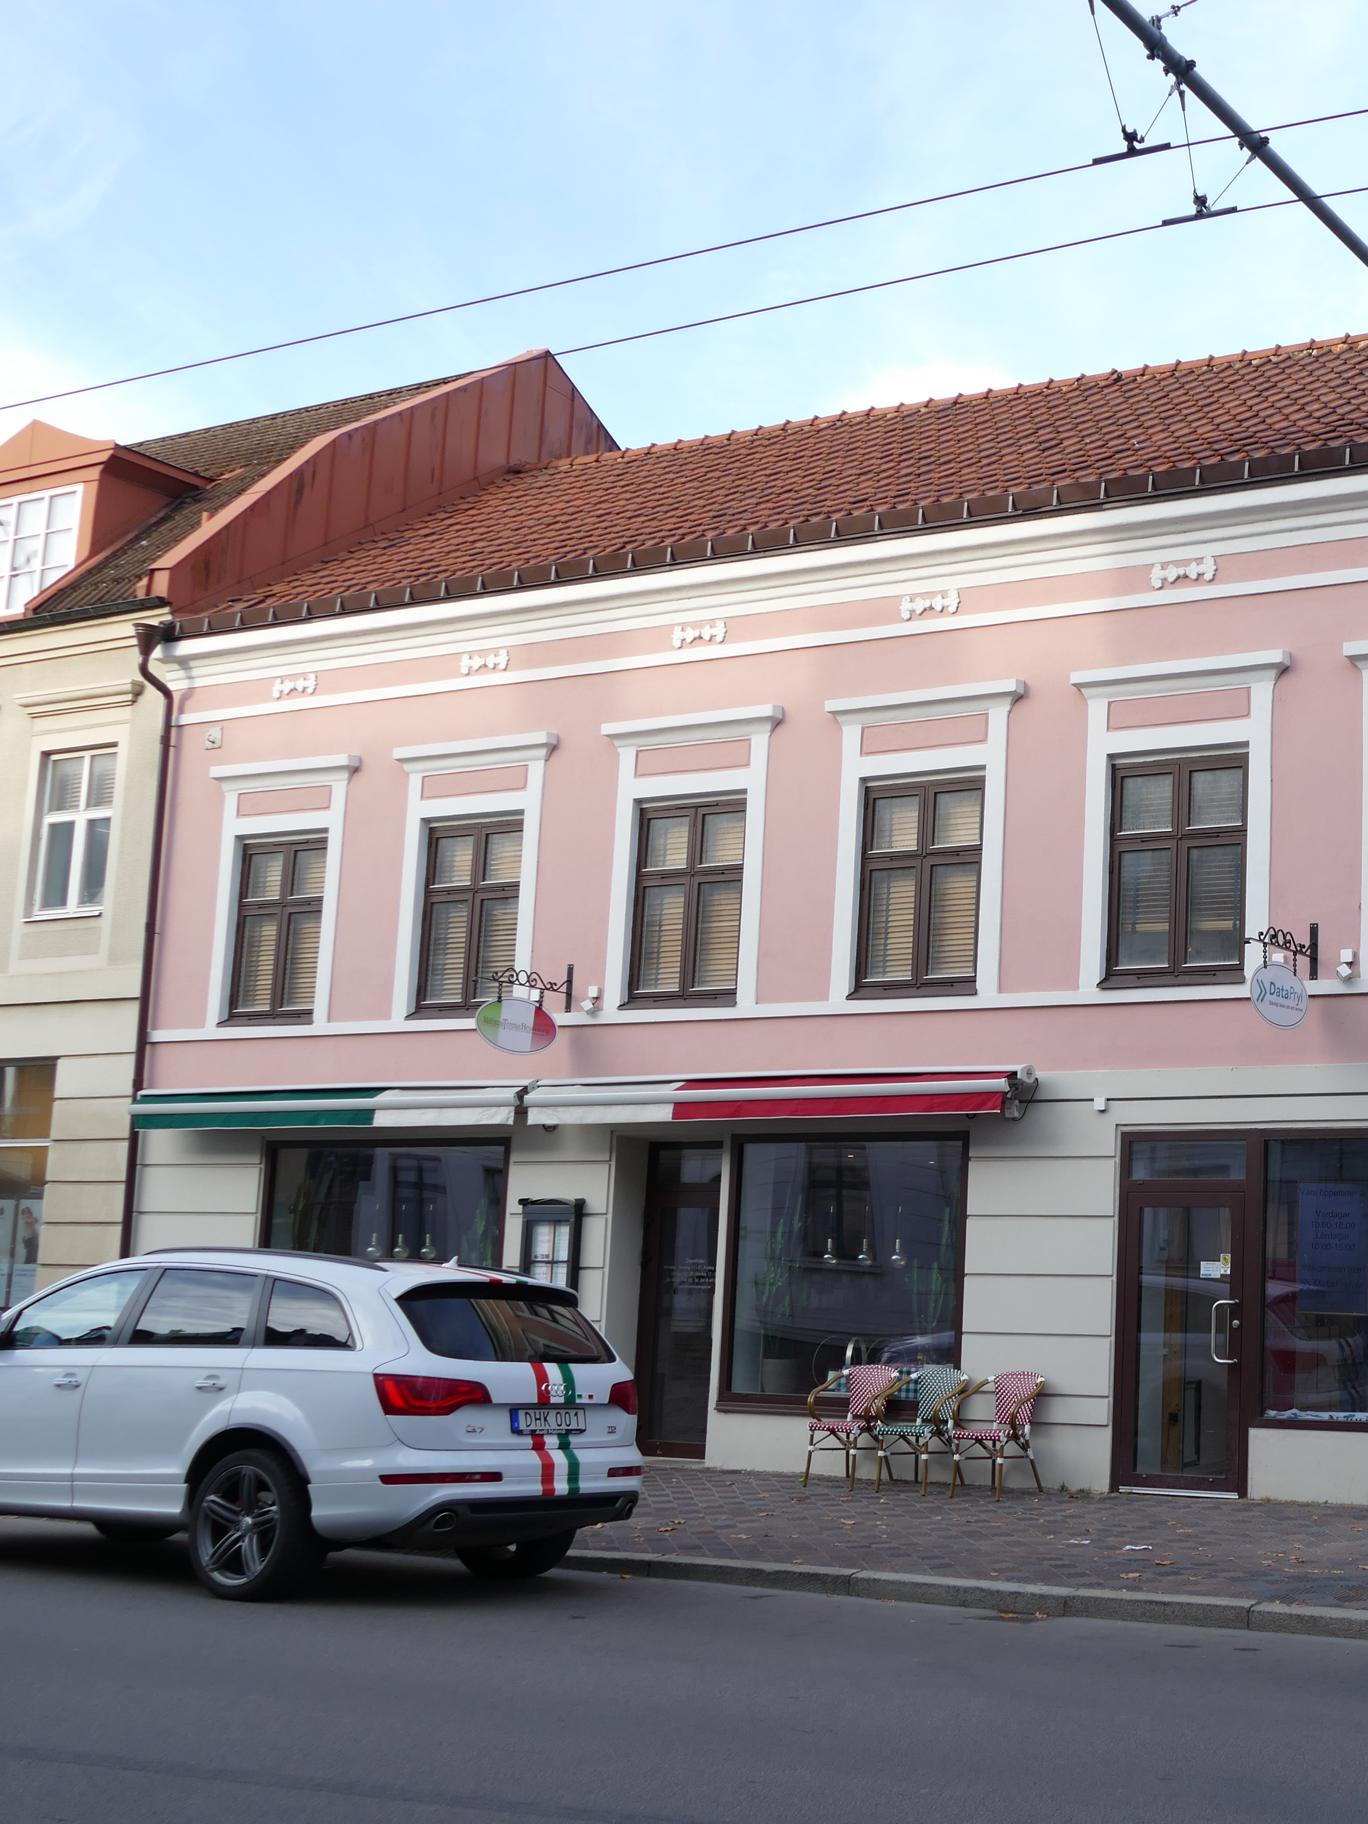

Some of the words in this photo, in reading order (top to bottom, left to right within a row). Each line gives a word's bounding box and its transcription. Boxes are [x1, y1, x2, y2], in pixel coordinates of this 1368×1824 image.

[1269, 981, 1303, 1006] DataPryl
[525, 1411, 552, 1428] DHK
[555, 1411, 580, 1428] 001
